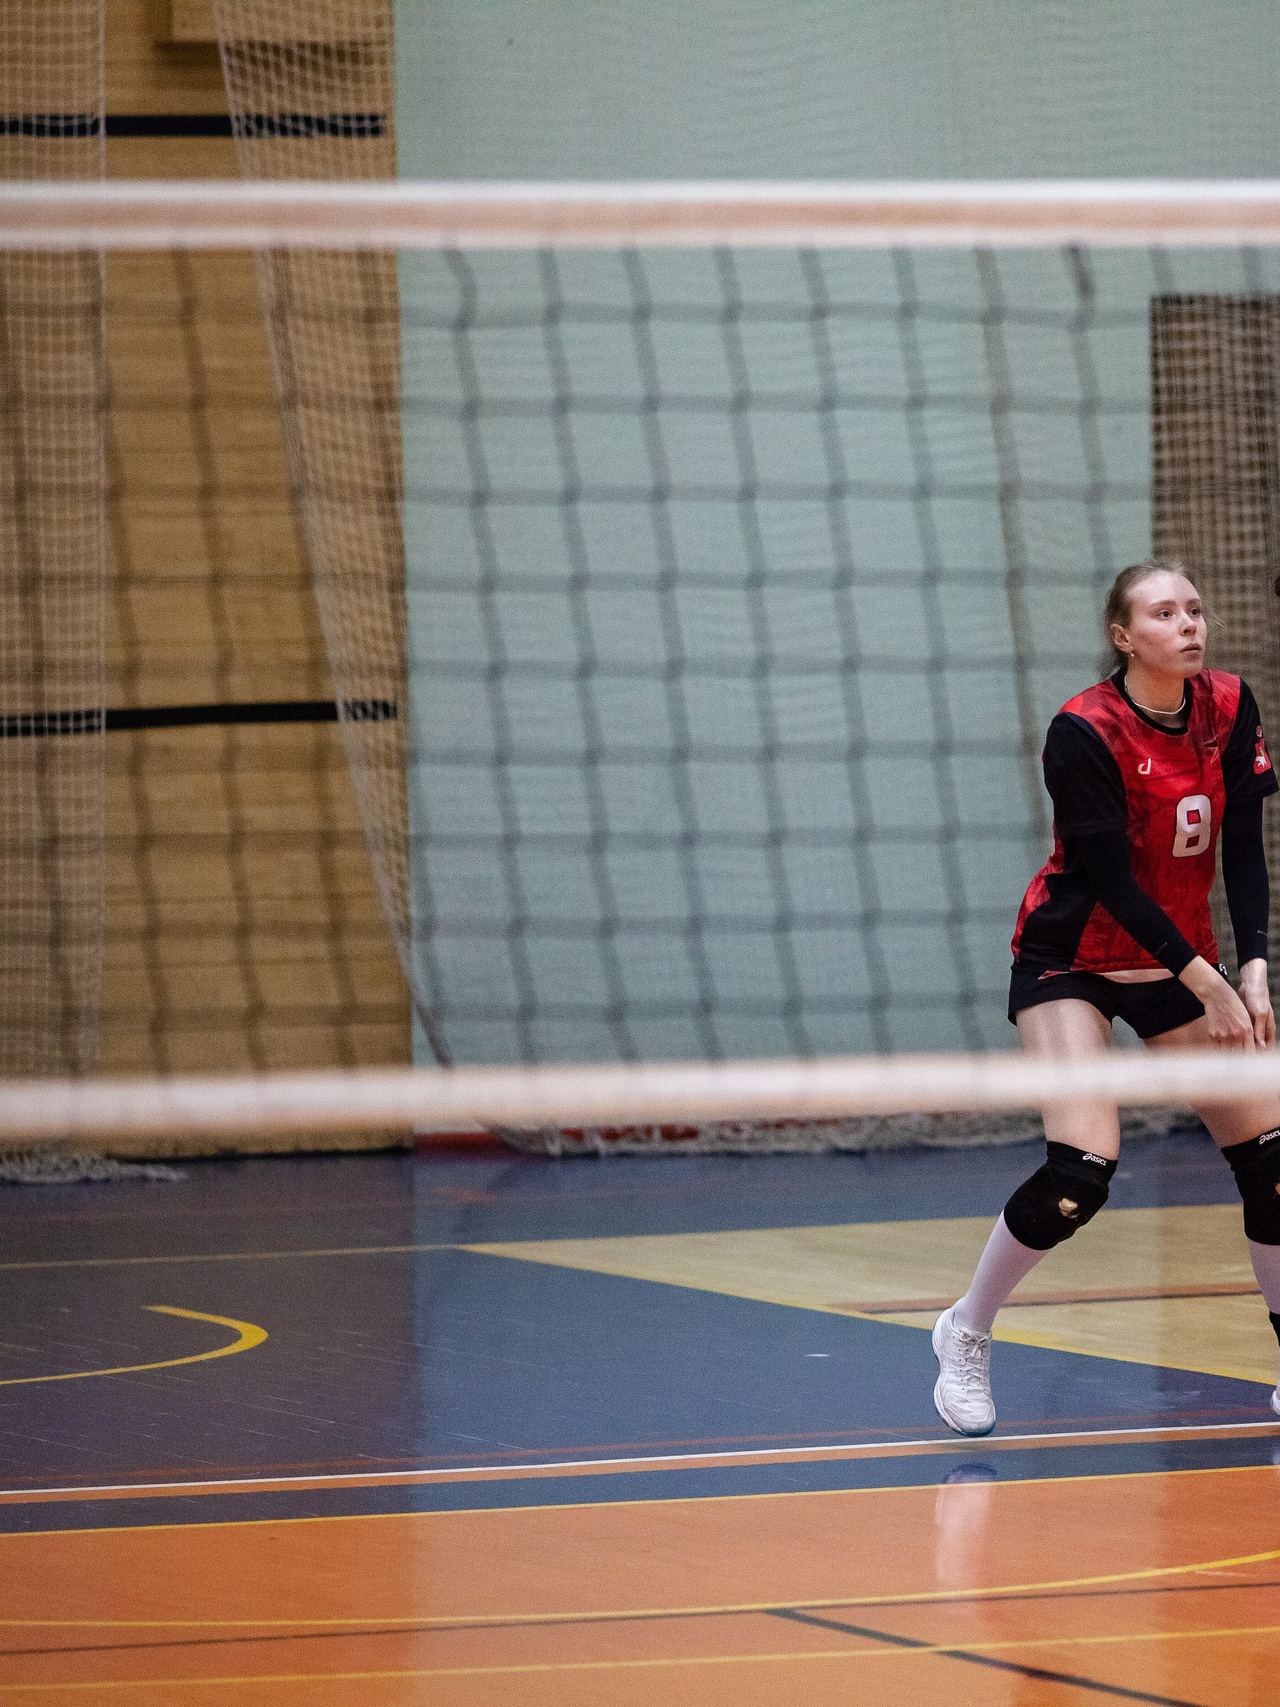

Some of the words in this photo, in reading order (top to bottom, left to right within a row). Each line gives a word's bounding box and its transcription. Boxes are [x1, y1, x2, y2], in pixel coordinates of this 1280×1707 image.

[1172, 794, 1212, 857] 8
[1259, 1130, 1280, 1145] asics
[1082, 1152, 1107, 1166] asics
